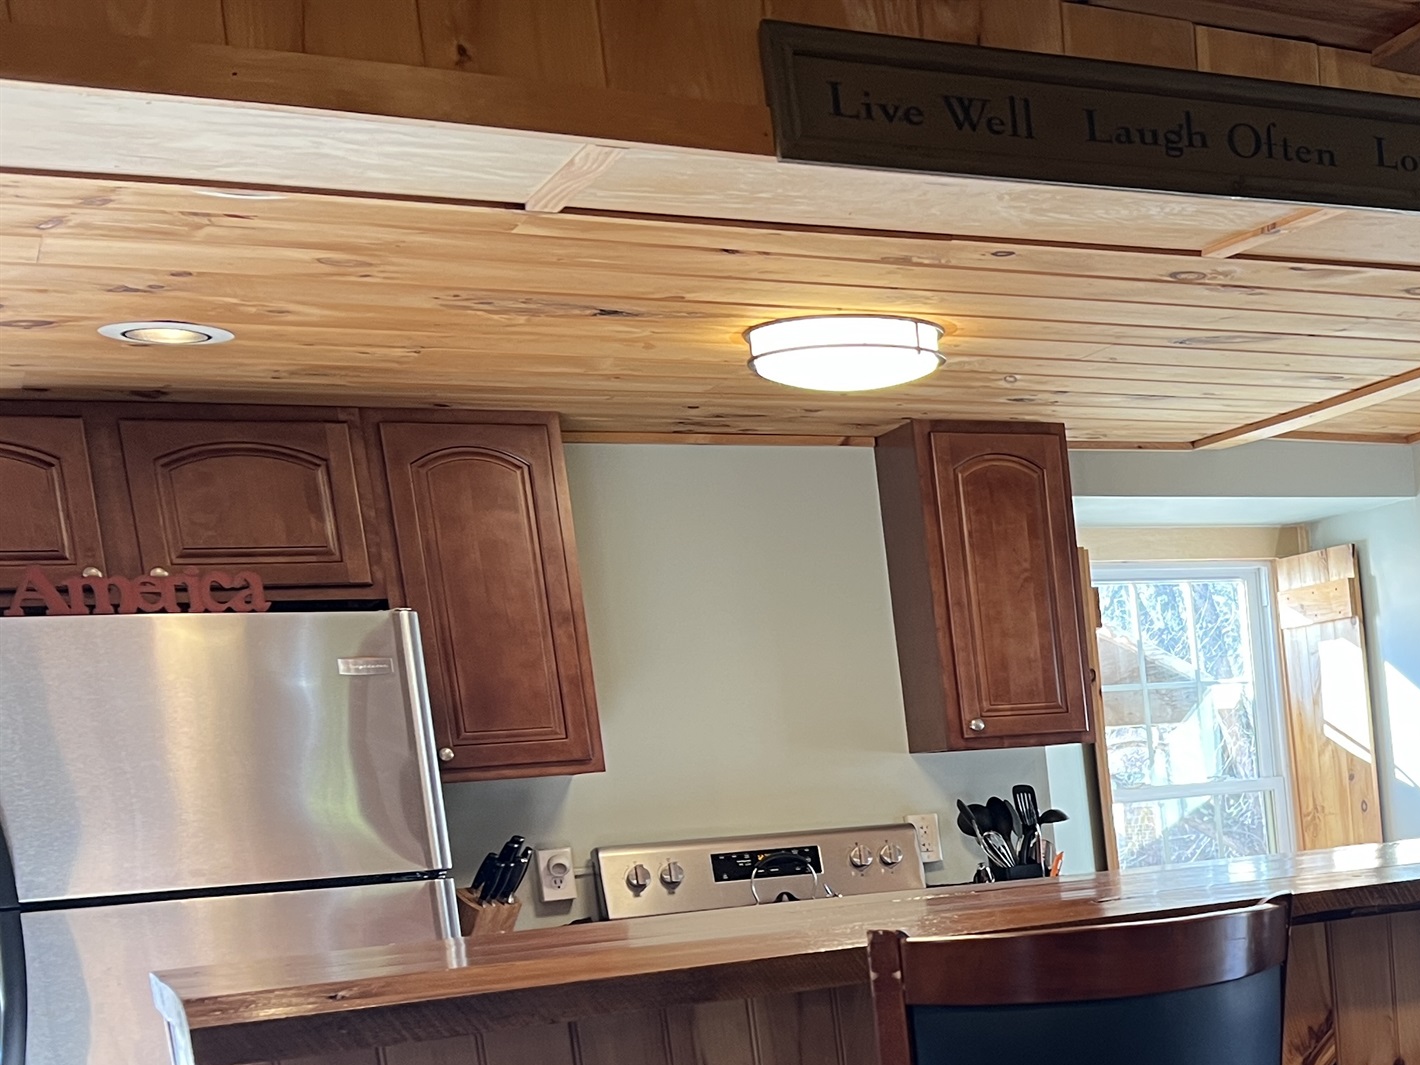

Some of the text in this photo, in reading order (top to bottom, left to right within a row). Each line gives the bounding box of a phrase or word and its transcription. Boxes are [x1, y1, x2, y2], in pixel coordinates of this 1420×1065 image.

[826, 80, 925, 127] Live
[942, 94, 1036, 140] Well
[1082, 107, 1210, 158] Laugh
[1227, 122, 1338, 167] Often
[4, 564, 272, 617] America
